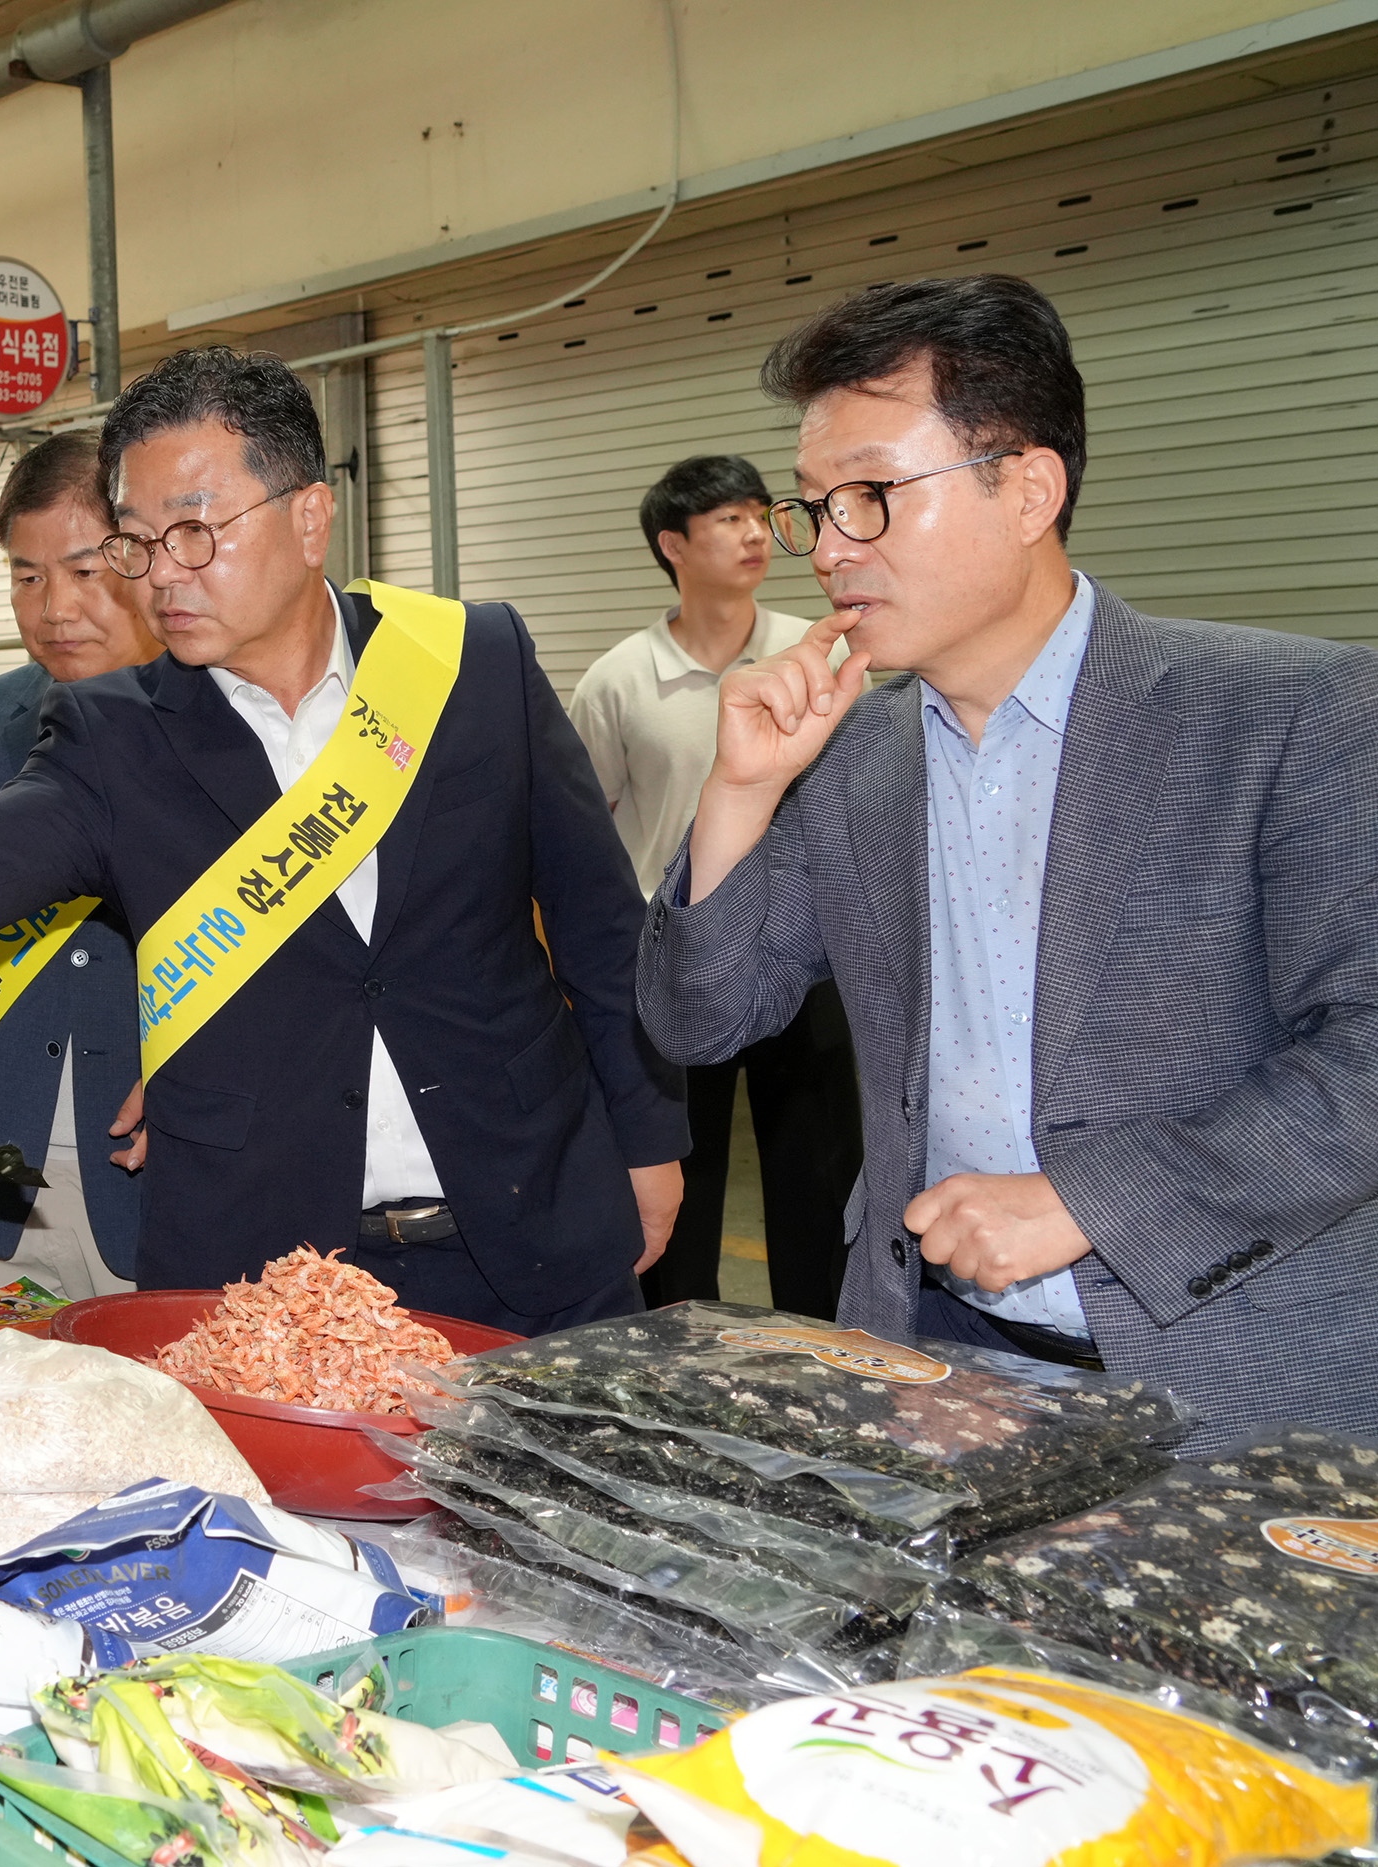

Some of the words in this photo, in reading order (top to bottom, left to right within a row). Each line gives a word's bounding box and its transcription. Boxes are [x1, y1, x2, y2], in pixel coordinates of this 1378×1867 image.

[236, 781, 369, 916] 전통시장
[235, 1597, 246, 1608] 70
[242, 1581, 255, 1599] kcal
[159, 1626, 209, 1650] 영양정보
